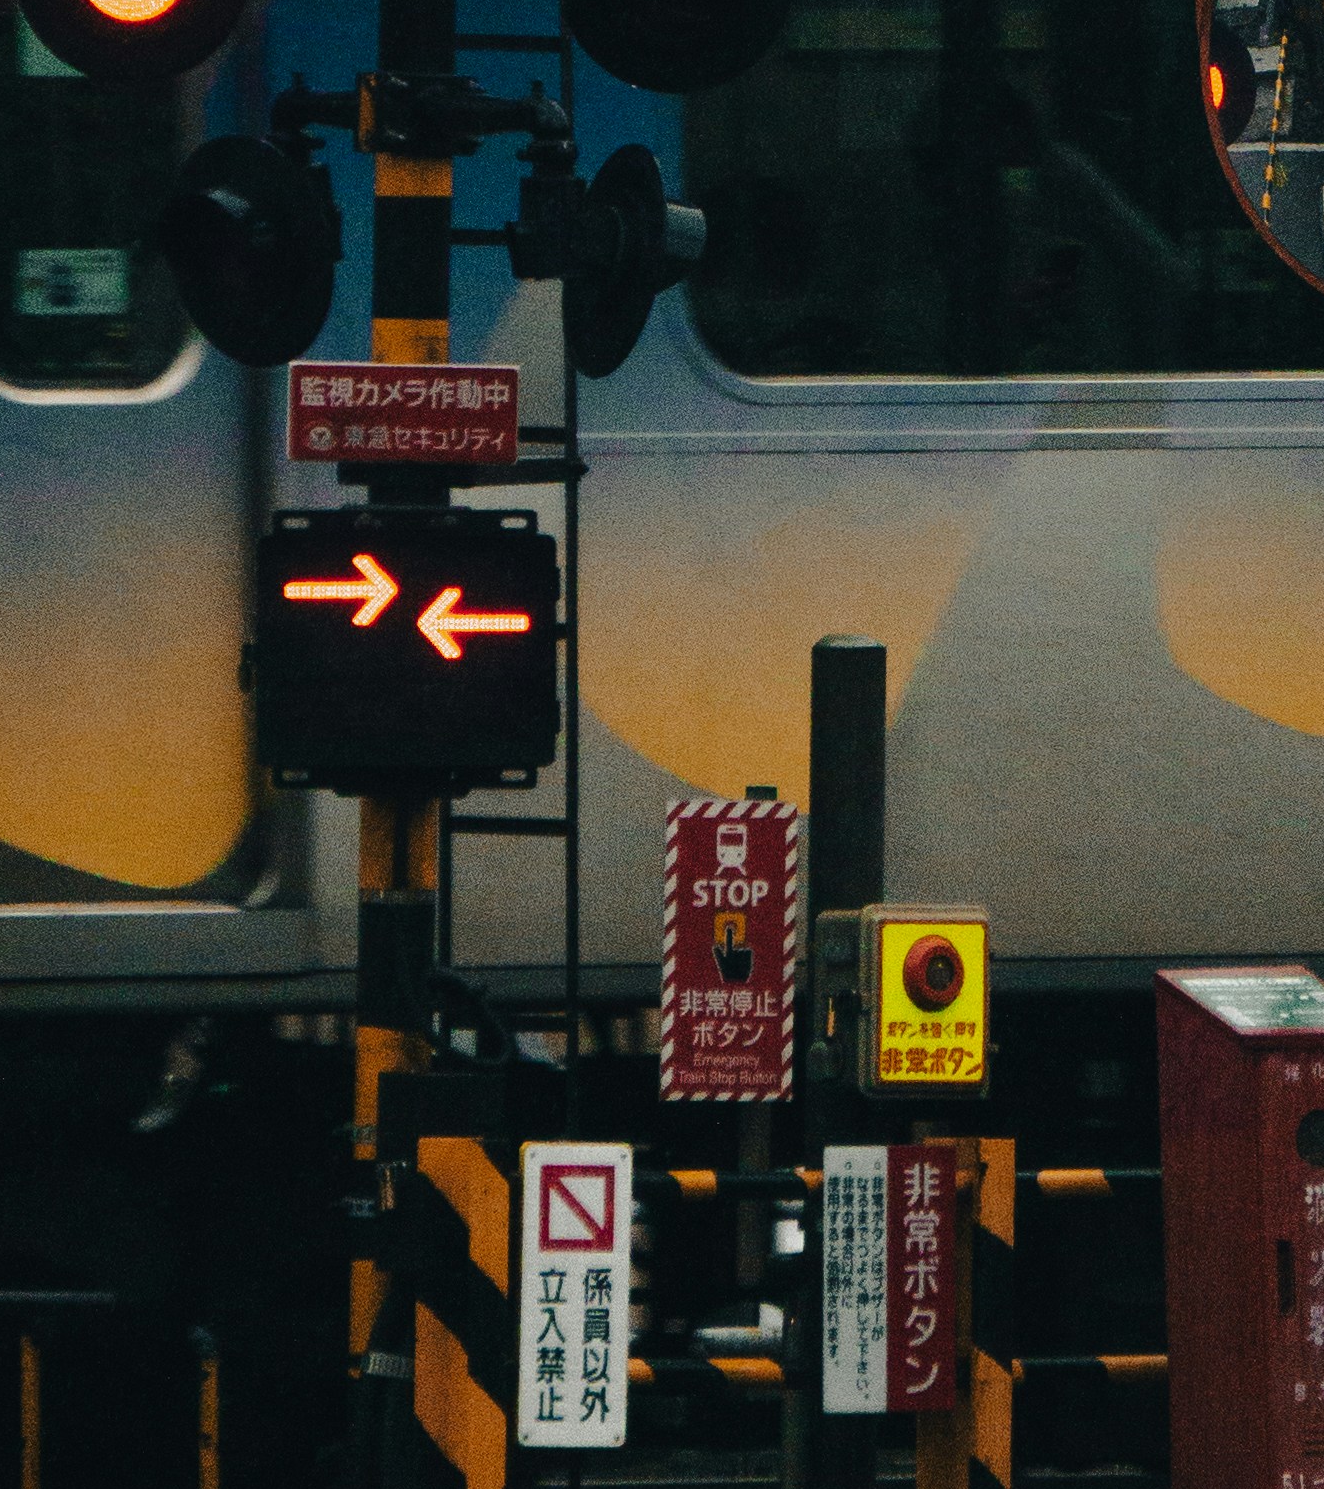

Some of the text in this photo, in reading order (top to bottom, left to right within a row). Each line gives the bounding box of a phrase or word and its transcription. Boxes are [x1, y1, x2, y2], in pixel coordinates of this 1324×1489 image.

[299, 376, 511, 410] 監視カメラ作動中
[343, 425, 505, 452] 東急セキュリティ
[692, 879, 770, 907] STOP
[679, 989, 779, 1019] 非常停止
[692, 1021, 766, 1048] ボタン
[886, 1021, 977, 1039] ボタンを強く押す
[692, 1052, 761, 1069] Emergency
[881, 1047, 982, 1076] 非常ボタン
[678, 1069, 778, 1086] Train Stop Button
[902, 1161, 942, 1395] 非常ボタン
[535, 1267, 568, 1423] 立入禁止
[579, 1267, 614, 1424] 係員以外
